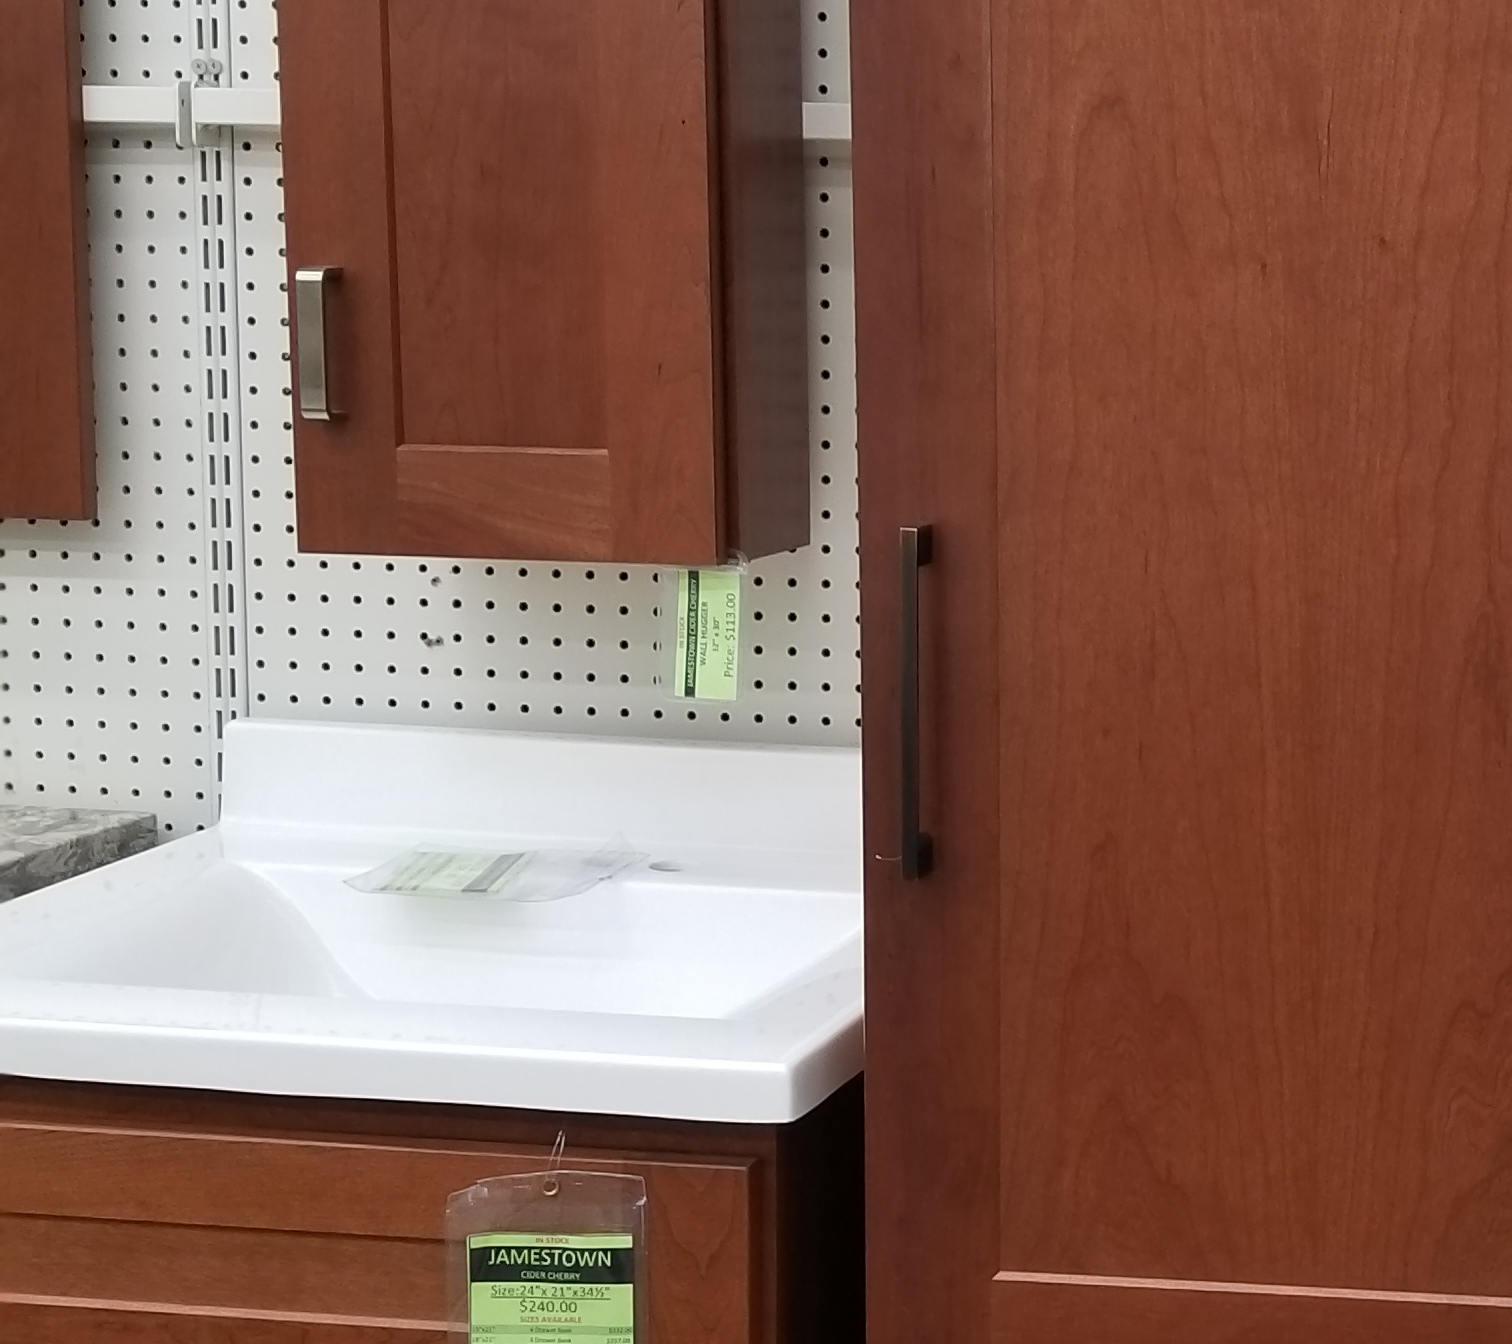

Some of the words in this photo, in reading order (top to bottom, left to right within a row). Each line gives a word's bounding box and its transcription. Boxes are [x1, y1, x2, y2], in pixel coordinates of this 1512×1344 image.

[725, 593, 736, 641] $113.00
[700, 643, 708, 666] WALL
[724, 645, 735, 678] Price:
[488, 1249, 611, 1268] JAMESTOWN
[521, 1271, 547, 1279] CIDER
[548, 1271, 581, 1280] CHERRY
[519, 1298, 578, 1313] $240.00
